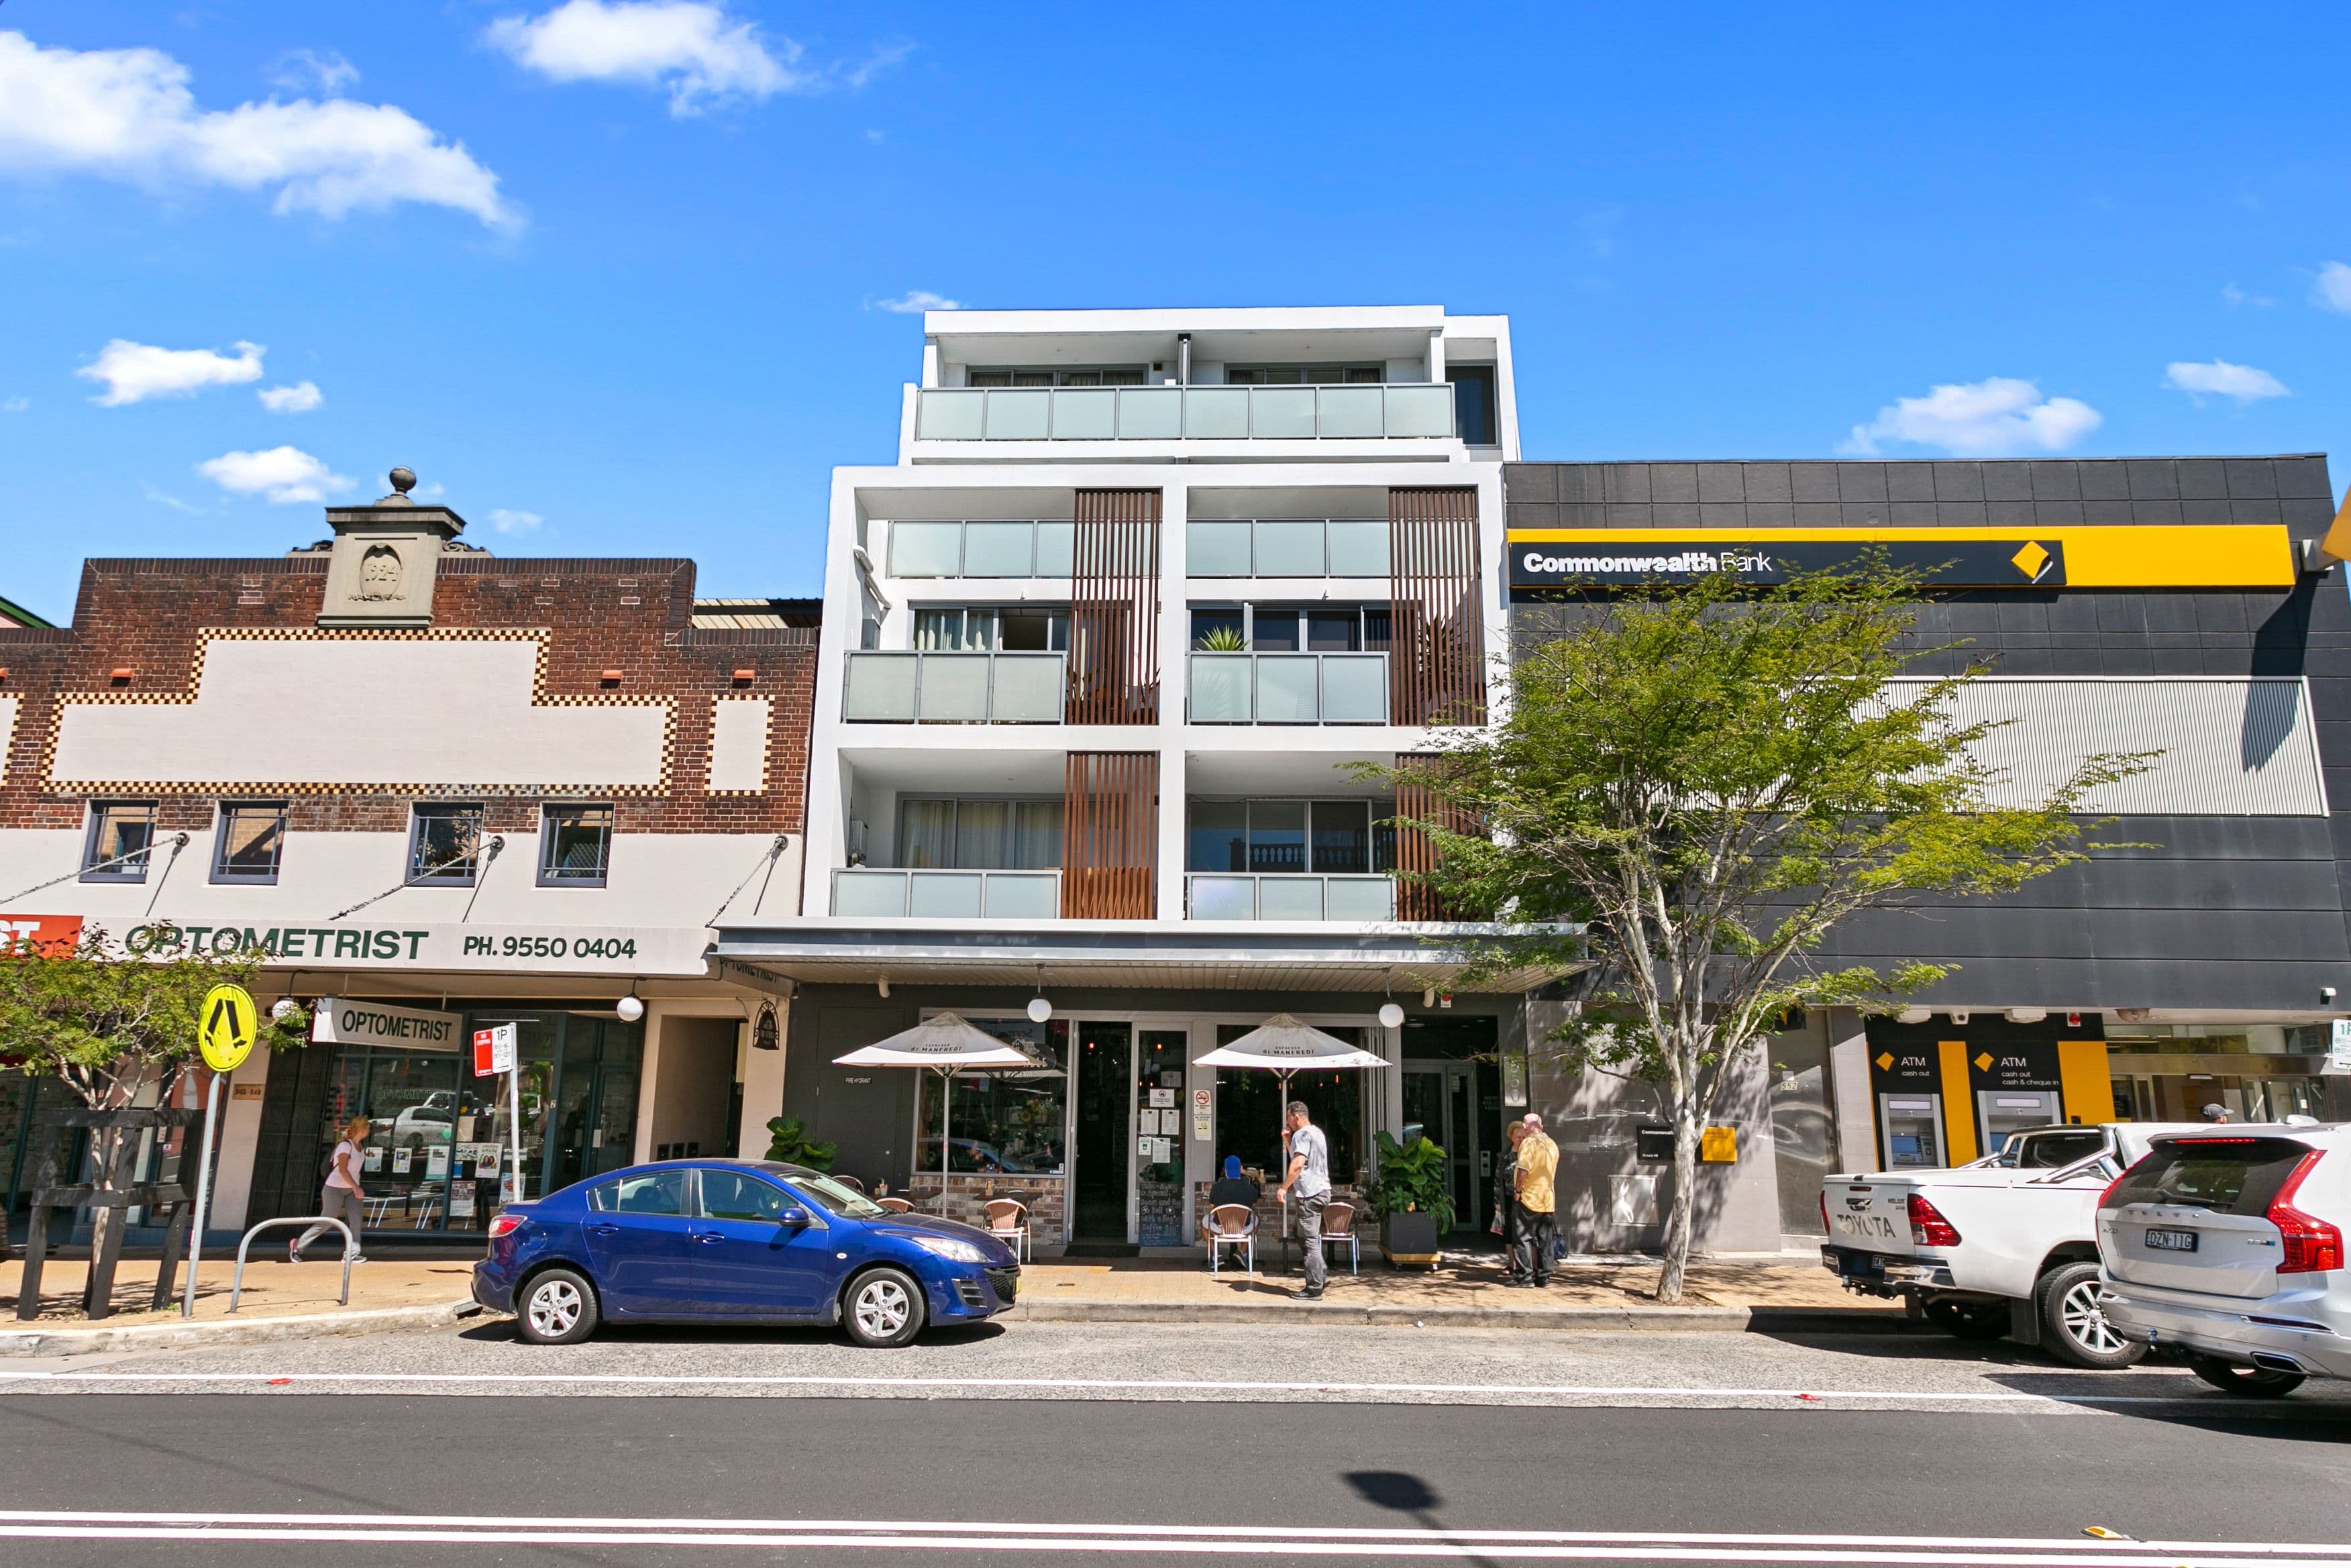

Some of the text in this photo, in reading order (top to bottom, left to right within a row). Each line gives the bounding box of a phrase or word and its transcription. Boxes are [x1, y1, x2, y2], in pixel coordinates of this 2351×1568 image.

[1524, 552, 1772, 572] Commonwealth Bank
[125, 925, 429, 959] OPTOMETRIST
[464, 936, 637, 959] PH. 9550 0404
[342, 1010, 452, 1041] OPTOMETRIST
[497, 1028, 508, 1041] 1P
[1901, 1057, 1926, 1067] ATM
[2001, 1057, 2026, 1067] ATM
[1837, 1214, 1896, 1238] TOYOTA
